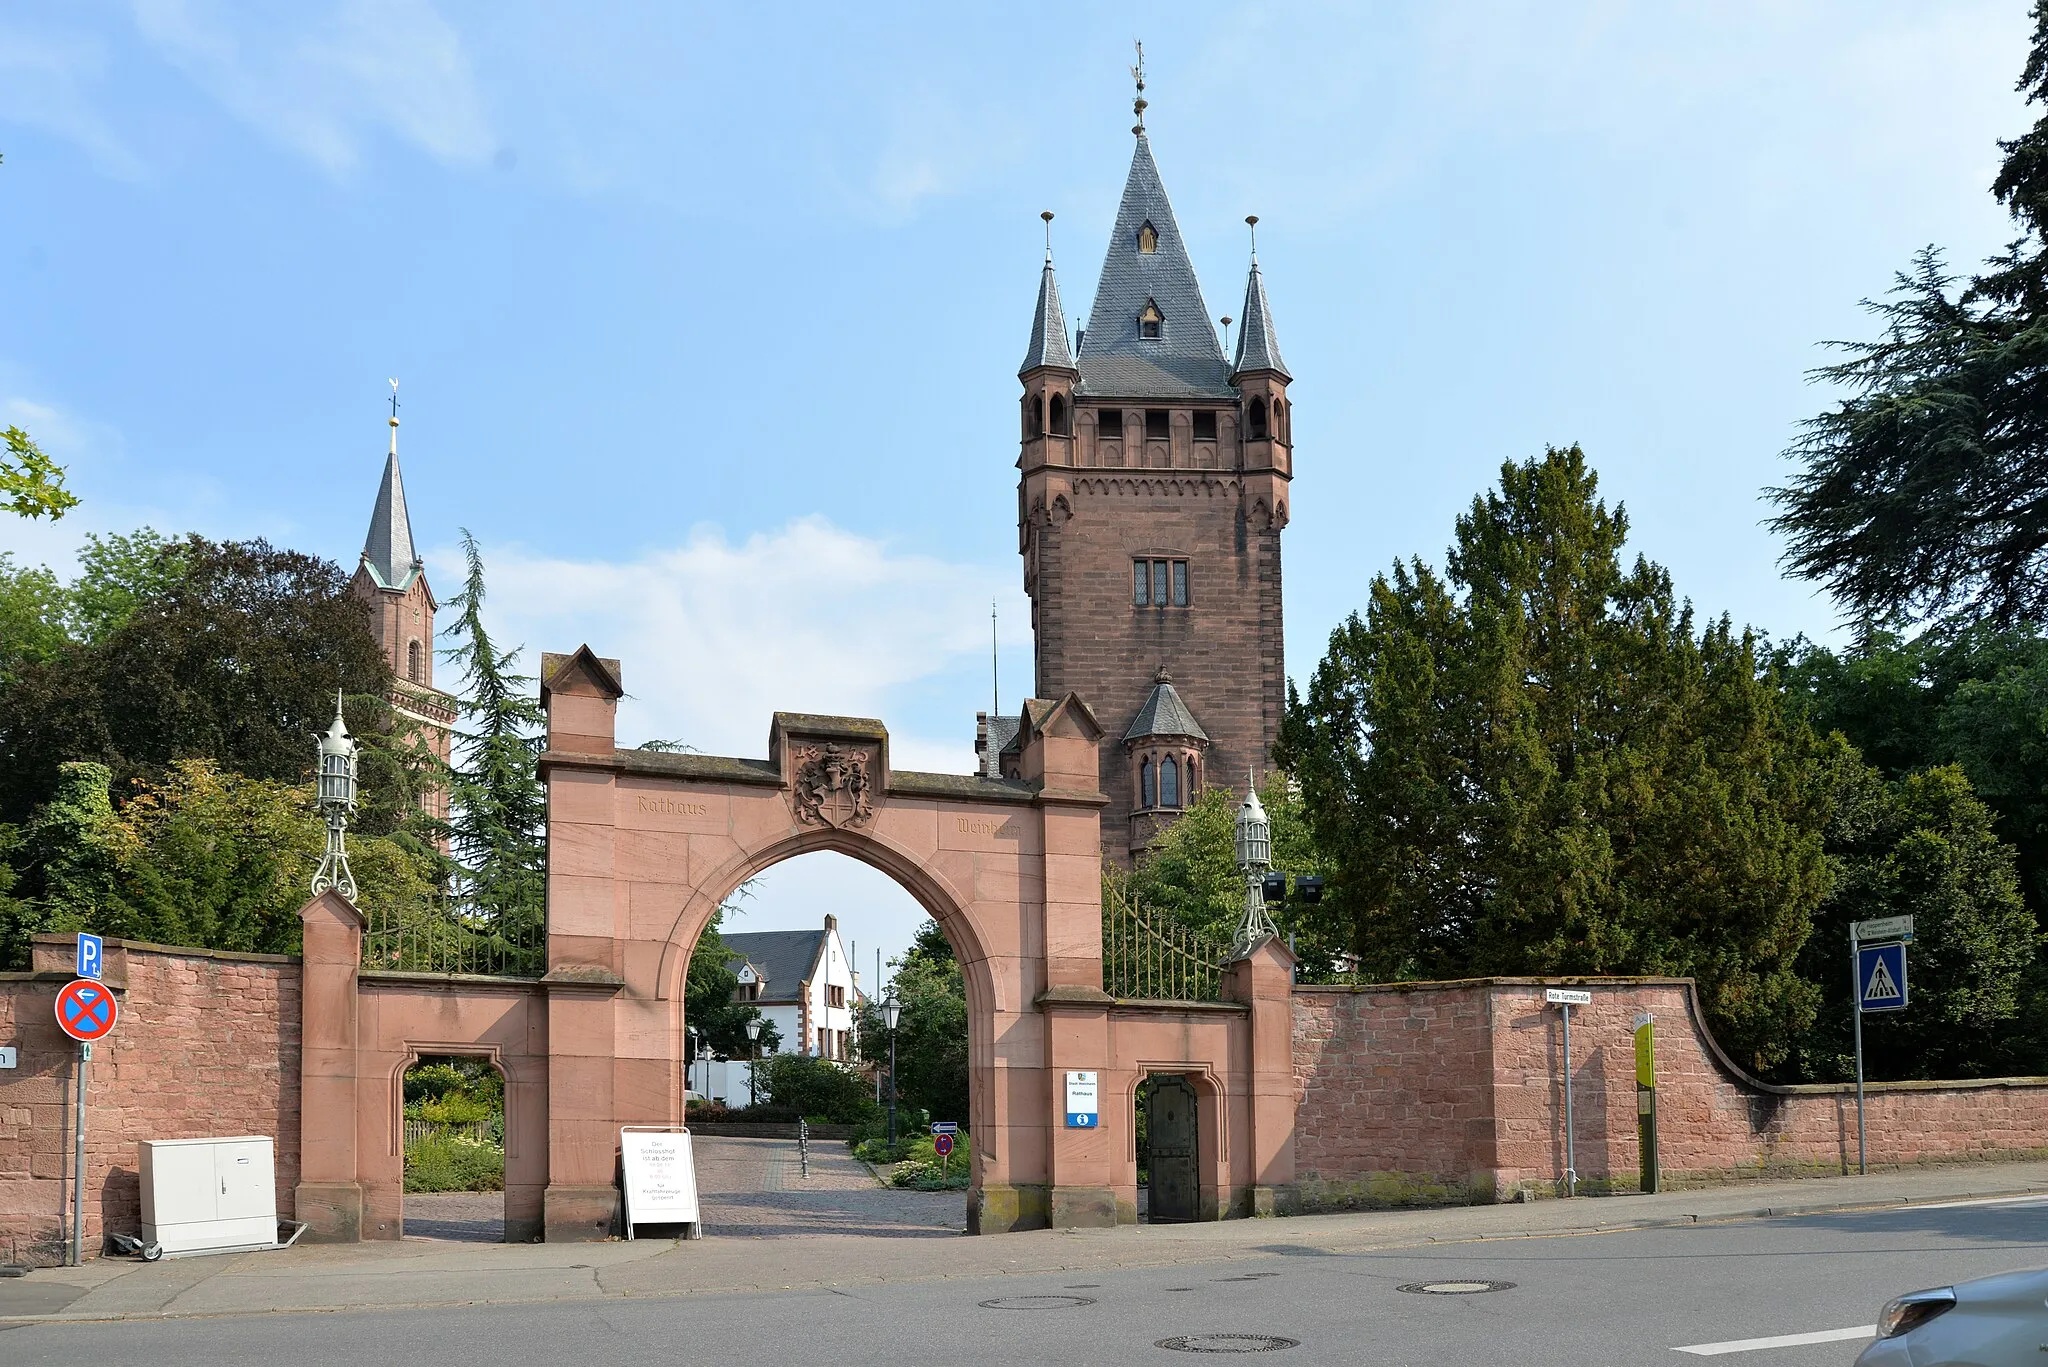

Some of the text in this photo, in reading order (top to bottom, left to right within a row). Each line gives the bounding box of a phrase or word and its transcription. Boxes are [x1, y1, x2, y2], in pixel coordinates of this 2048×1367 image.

[638, 796, 707, 815] Rathaus
[83, 940, 97, 972] P
[1548, 991, 1589, 1002] Rote Turmstraße
